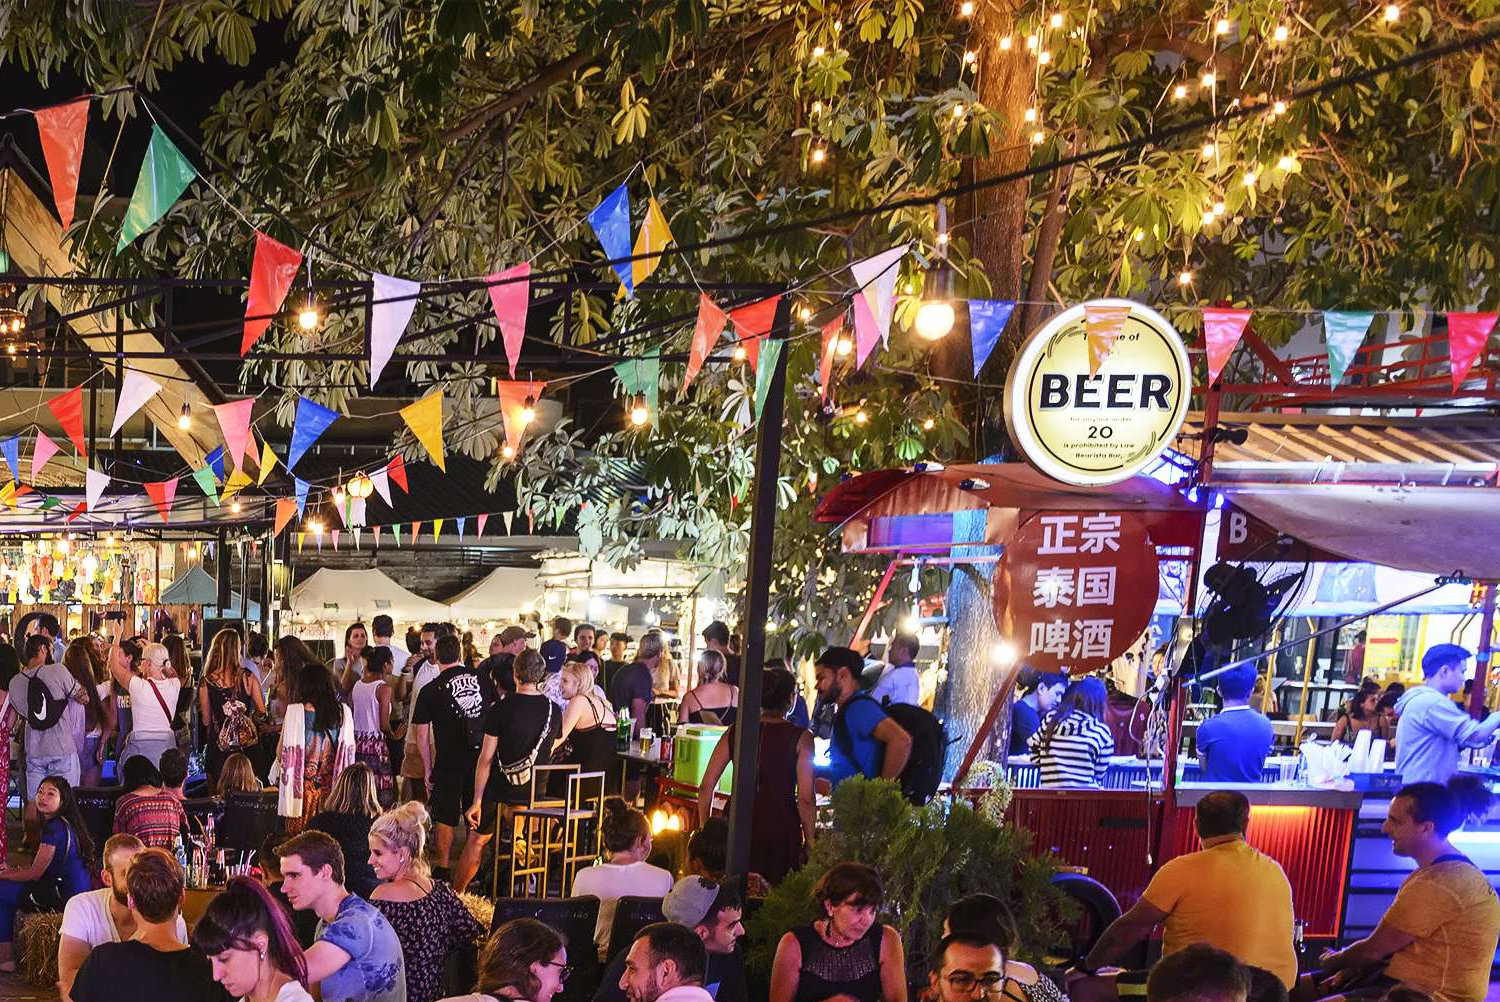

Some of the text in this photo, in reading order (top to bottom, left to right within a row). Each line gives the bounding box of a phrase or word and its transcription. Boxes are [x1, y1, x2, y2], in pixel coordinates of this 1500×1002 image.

[1129, 332, 1140, 341] of
[1040, 374, 1172, 409] BEER
[1087, 426, 1113, 439] 20
[1037, 512, 1122, 555] 正宗
[1033, 566, 1117, 609] 泰国
[1029, 618, 1115, 660] 啤酒
